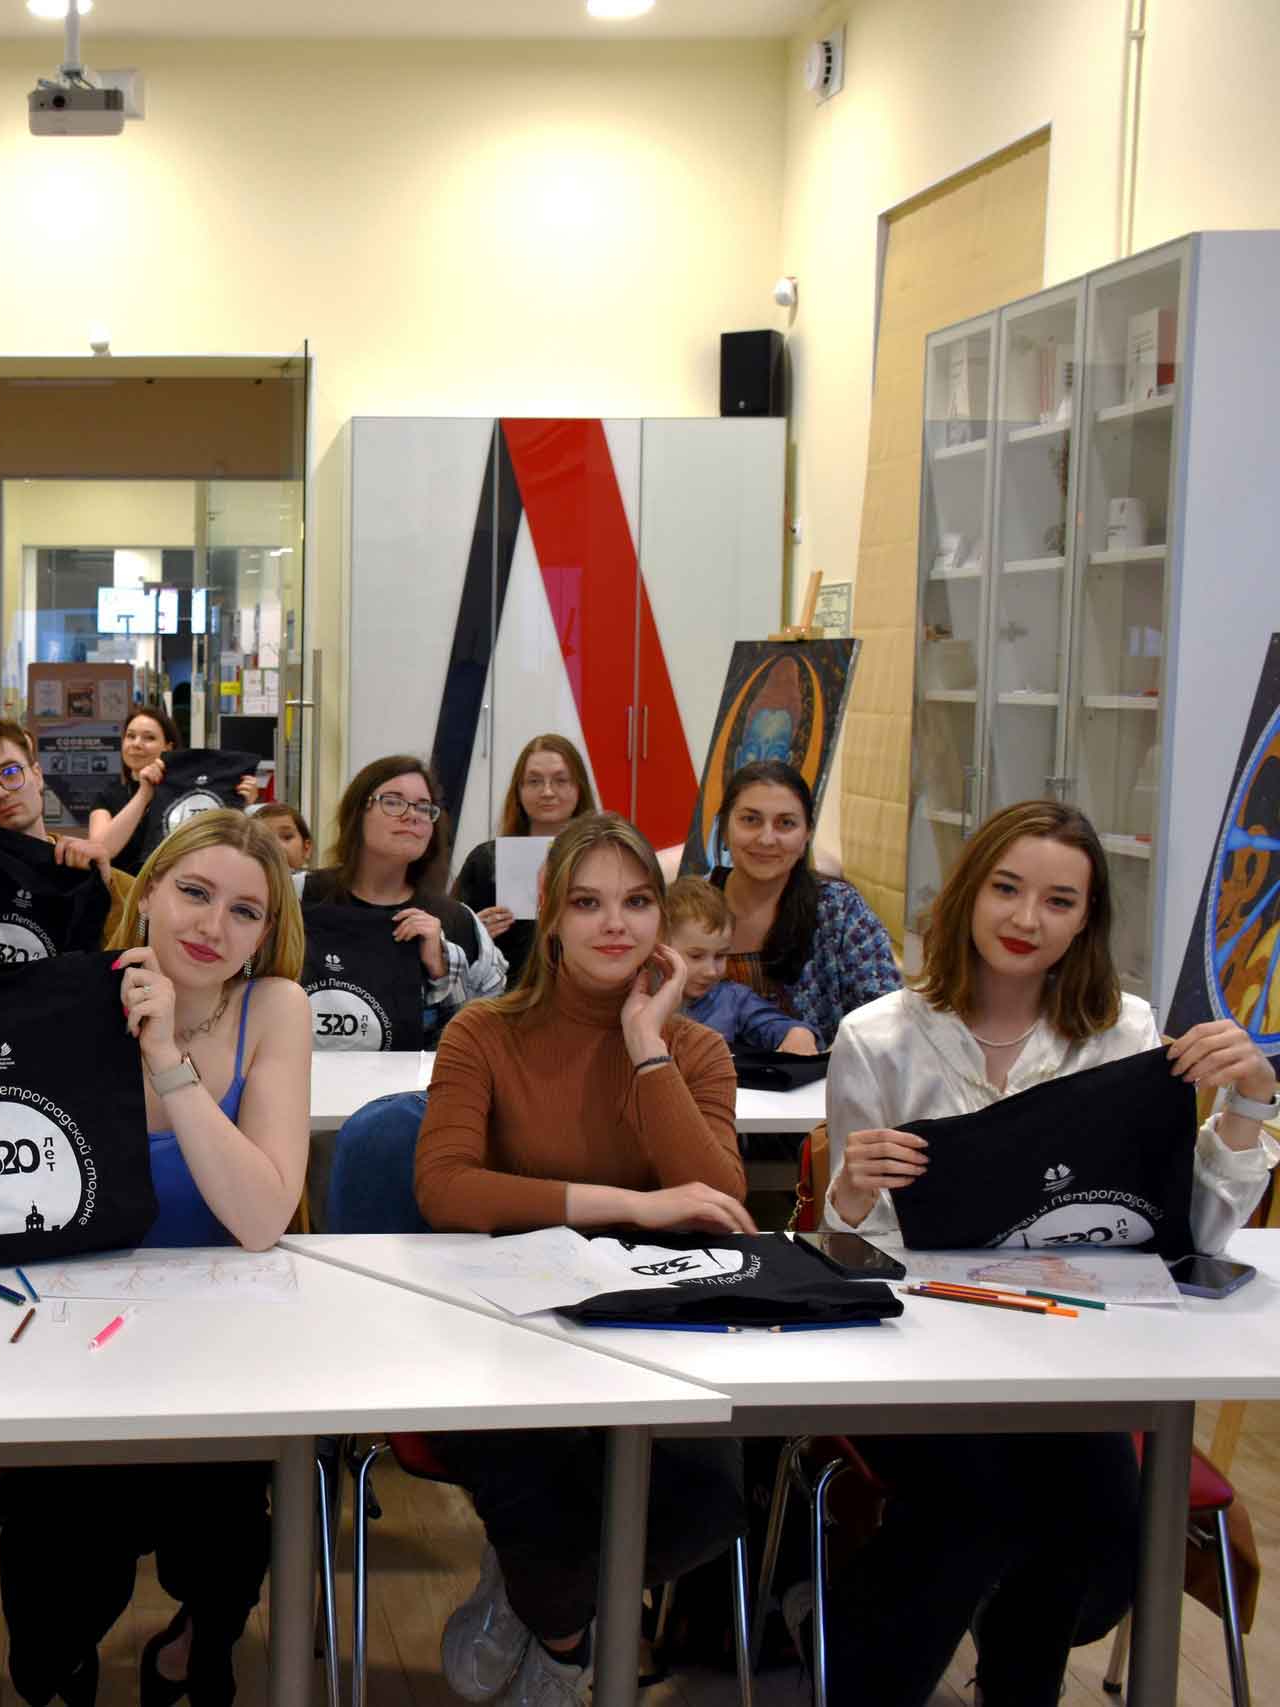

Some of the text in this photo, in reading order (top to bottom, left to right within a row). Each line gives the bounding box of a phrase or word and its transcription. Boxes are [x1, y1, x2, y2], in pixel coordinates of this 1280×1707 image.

[316, 1013, 358, 1037] 320
[43, 1136, 56, 1173] лет
[78, 1158, 98, 1227] стороне
[631, 1255, 702, 1276] 320
